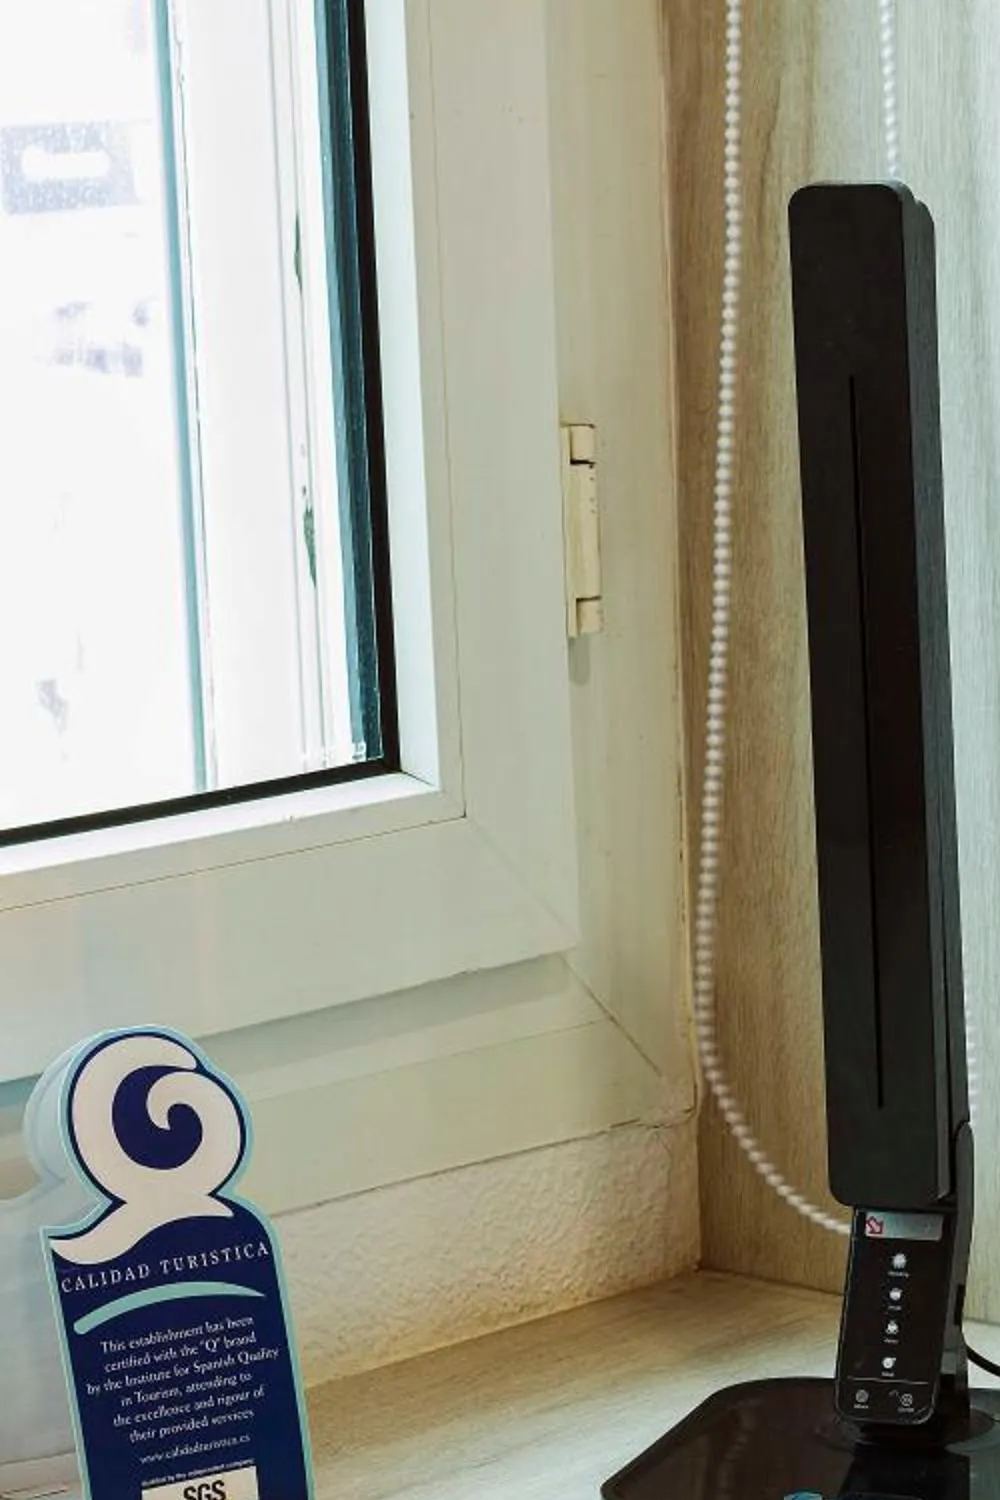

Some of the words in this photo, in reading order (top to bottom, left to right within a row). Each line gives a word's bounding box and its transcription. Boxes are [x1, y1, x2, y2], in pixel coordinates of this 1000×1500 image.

[61, 1263, 150, 1293] CALIDAD
[159, 1241, 269, 1275] TURISTICA
[100, 1339, 127, 1354] This
[128, 1325, 204, 1350] establishment
[204, 1321, 224, 1334] has
[225, 1317, 254, 1330] been
[104, 1352, 151, 1373] certified
[153, 1347, 178, 1362] with
[180, 1344, 199, 1357] the
[223, 1330, 257, 1350] brand
[86, 1383, 101, 1398] by
[103, 1378, 123, 1391] the
[125, 1370, 171, 1388] Institute
[173, 1363, 189, 1377] for
[193, 1353, 236, 1375] Spanish
[237, 1346, 279, 1365] Quality
[113, 1413, 132, 1428] the
[134, 1404, 191, 1424] excellence
[193, 1395, 215, 1411] and
[217, 1391, 250, 1407] rigour
[253, 1384, 265, 1399] of
[121, 1396, 133, 1407] in
[129, 1428, 157, 1444] their
[160, 1415, 209, 1439] provided
